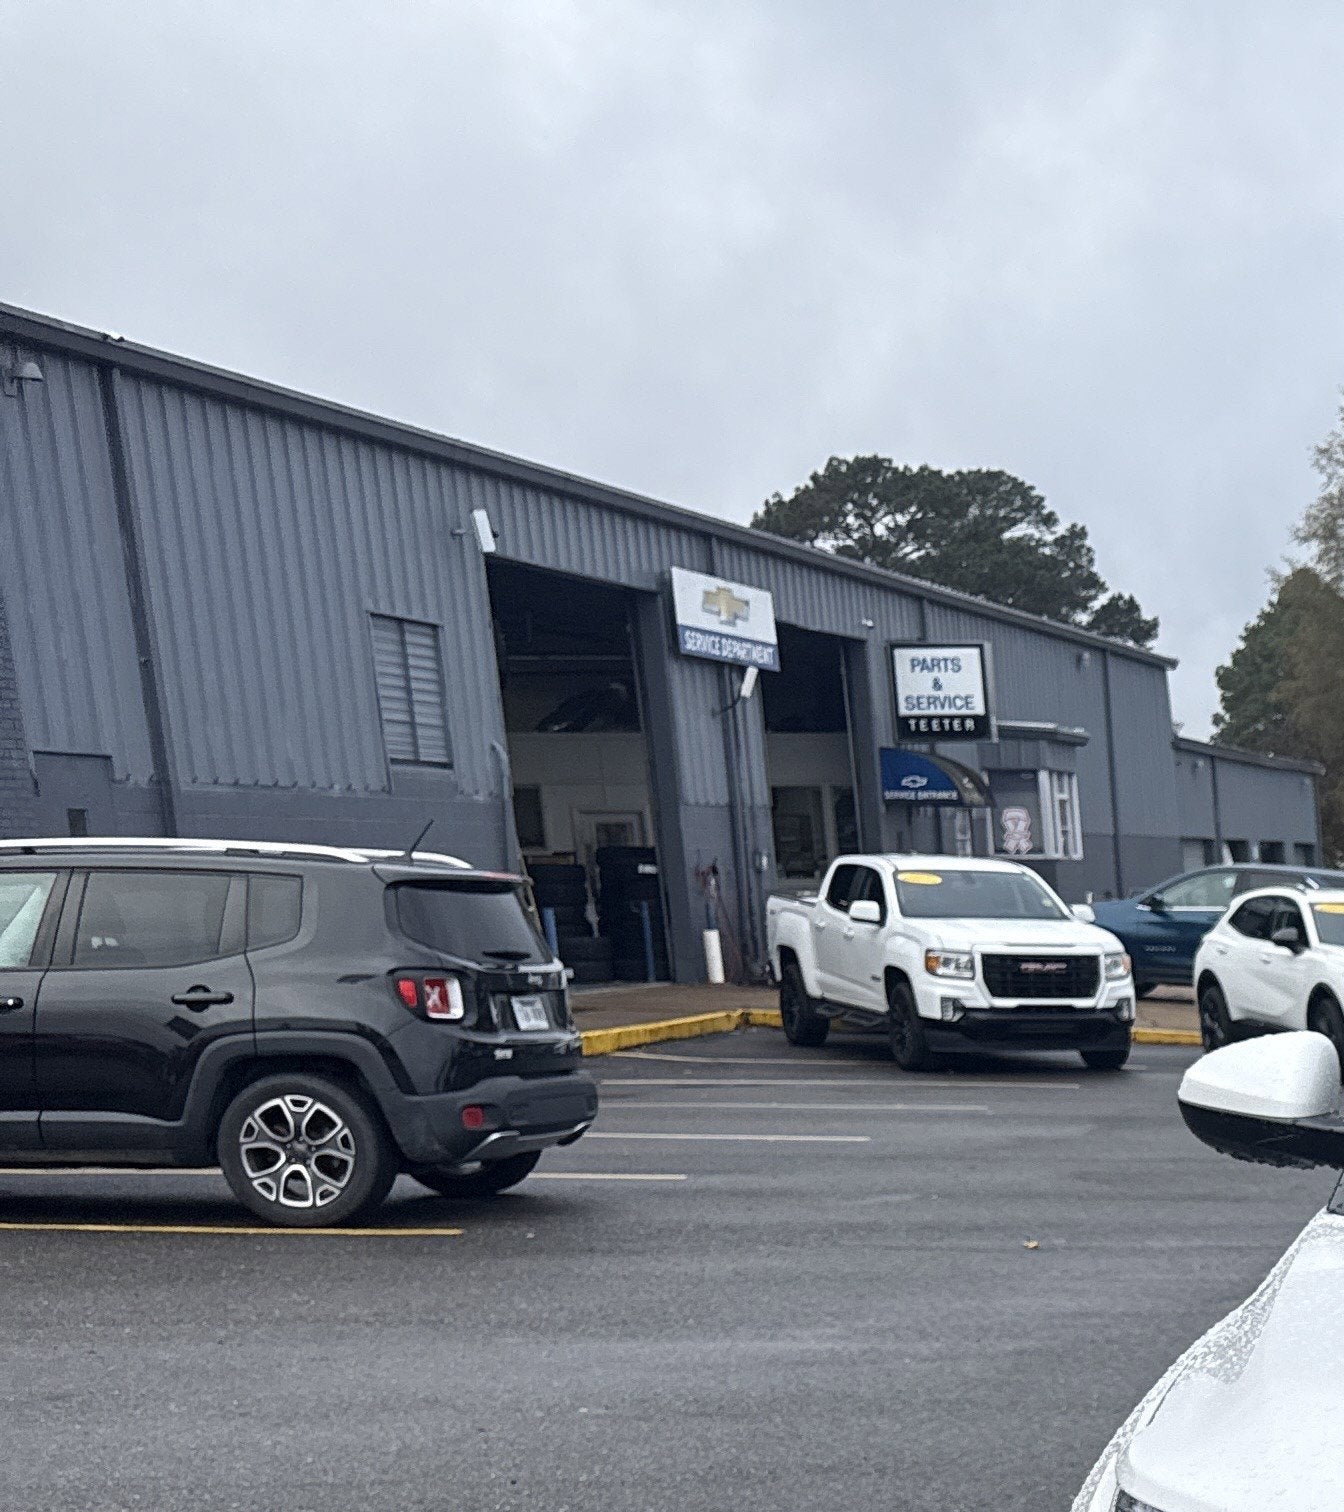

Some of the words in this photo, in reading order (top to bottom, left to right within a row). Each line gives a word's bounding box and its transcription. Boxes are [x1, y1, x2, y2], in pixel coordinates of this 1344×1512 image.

[684, 630, 720, 656] SERVICE
[721, 638, 774, 665] DEPARTMENT
[910, 657, 962, 673] PARTS
[932, 676, 943, 691] &
[904, 694, 975, 711] SERVICE
[908, 718, 975, 732] TEETER
